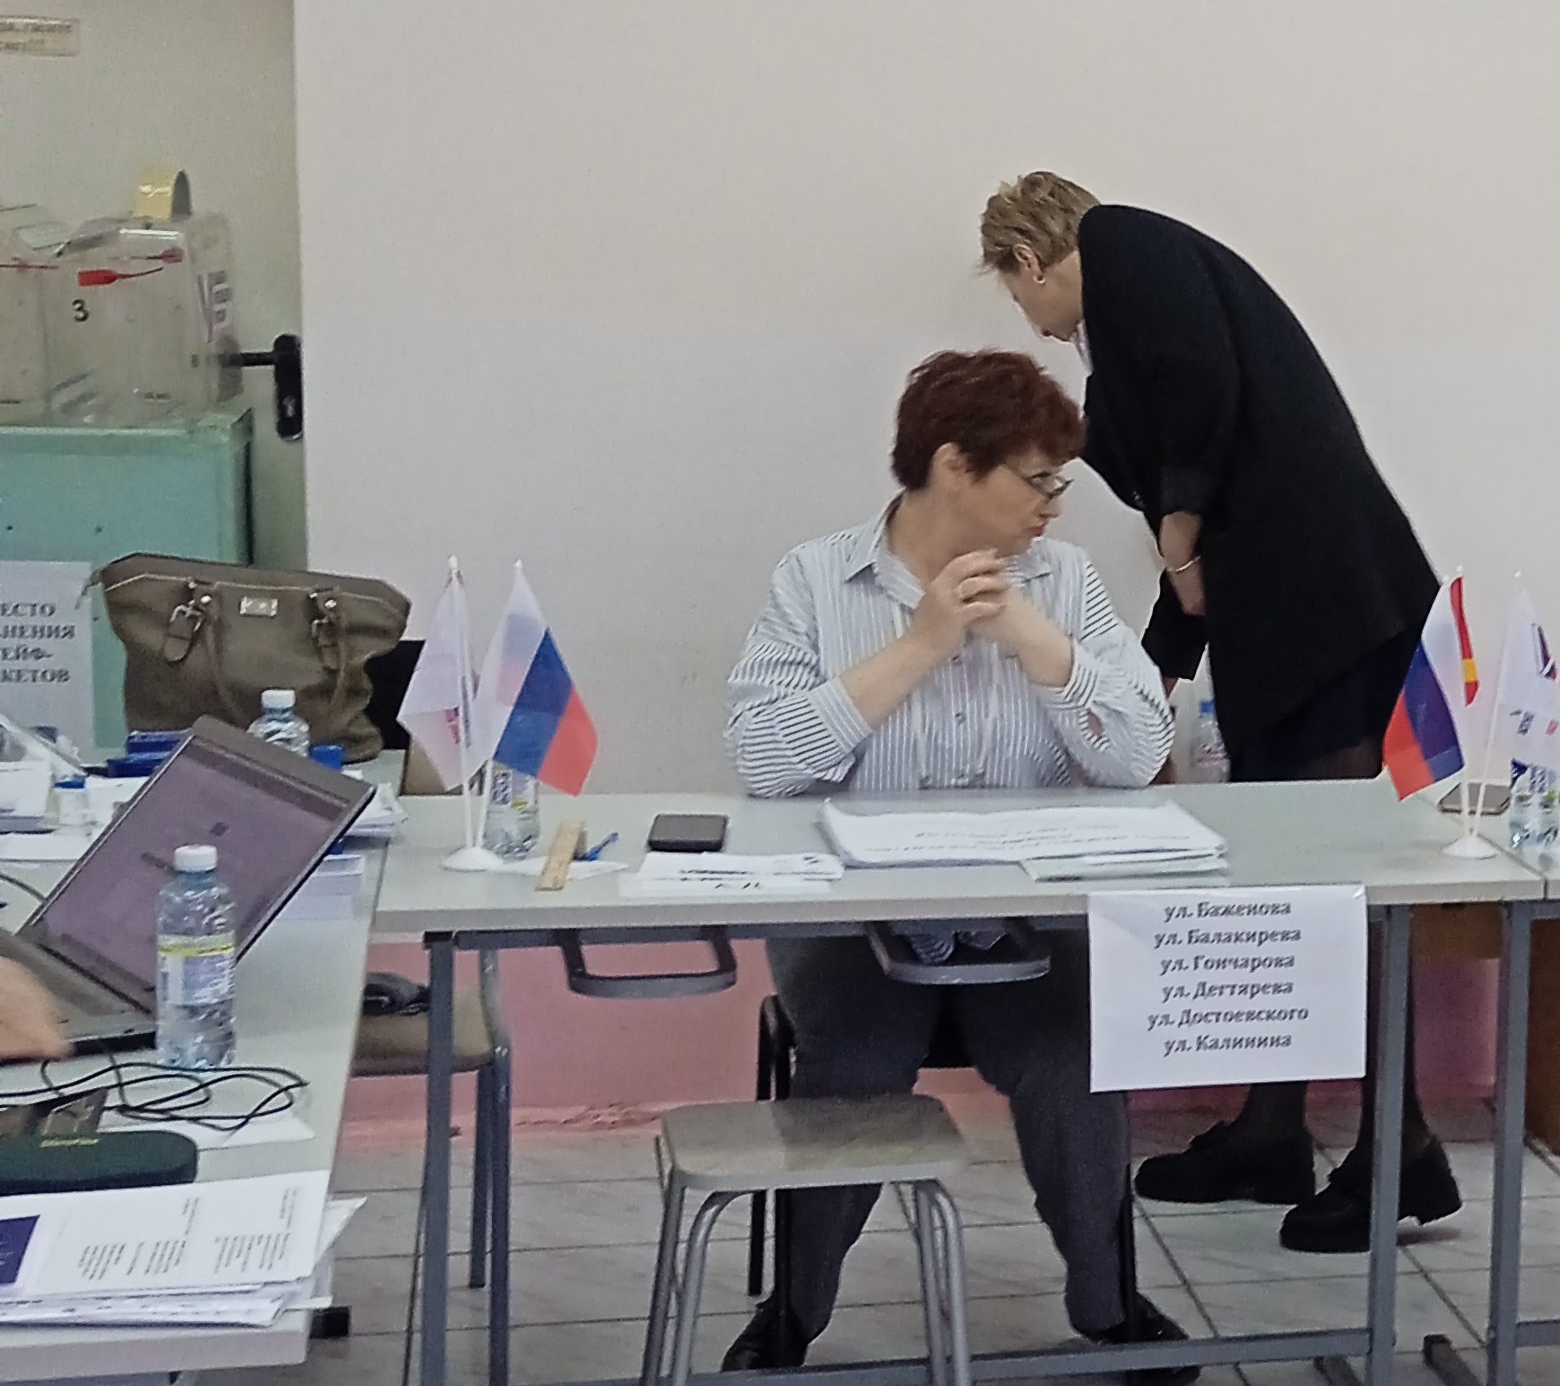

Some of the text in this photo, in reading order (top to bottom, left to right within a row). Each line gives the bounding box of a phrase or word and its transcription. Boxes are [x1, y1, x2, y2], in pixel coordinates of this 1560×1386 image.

[71, 298, 90, 323] 3
[0, 625, 75, 639] НЕНИЯ
[1164, 902, 1291, 922] ул. Баженова
[1154, 929, 1301, 949] ул. Балакирева
[1160, 955, 1295, 976] ул. Гончарова
[1163, 984, 1190, 1003] ул.
[1148, 1008, 1309, 1031] ул. Достоевского
[1164, 1035, 1292, 1057] ул. Калинина
